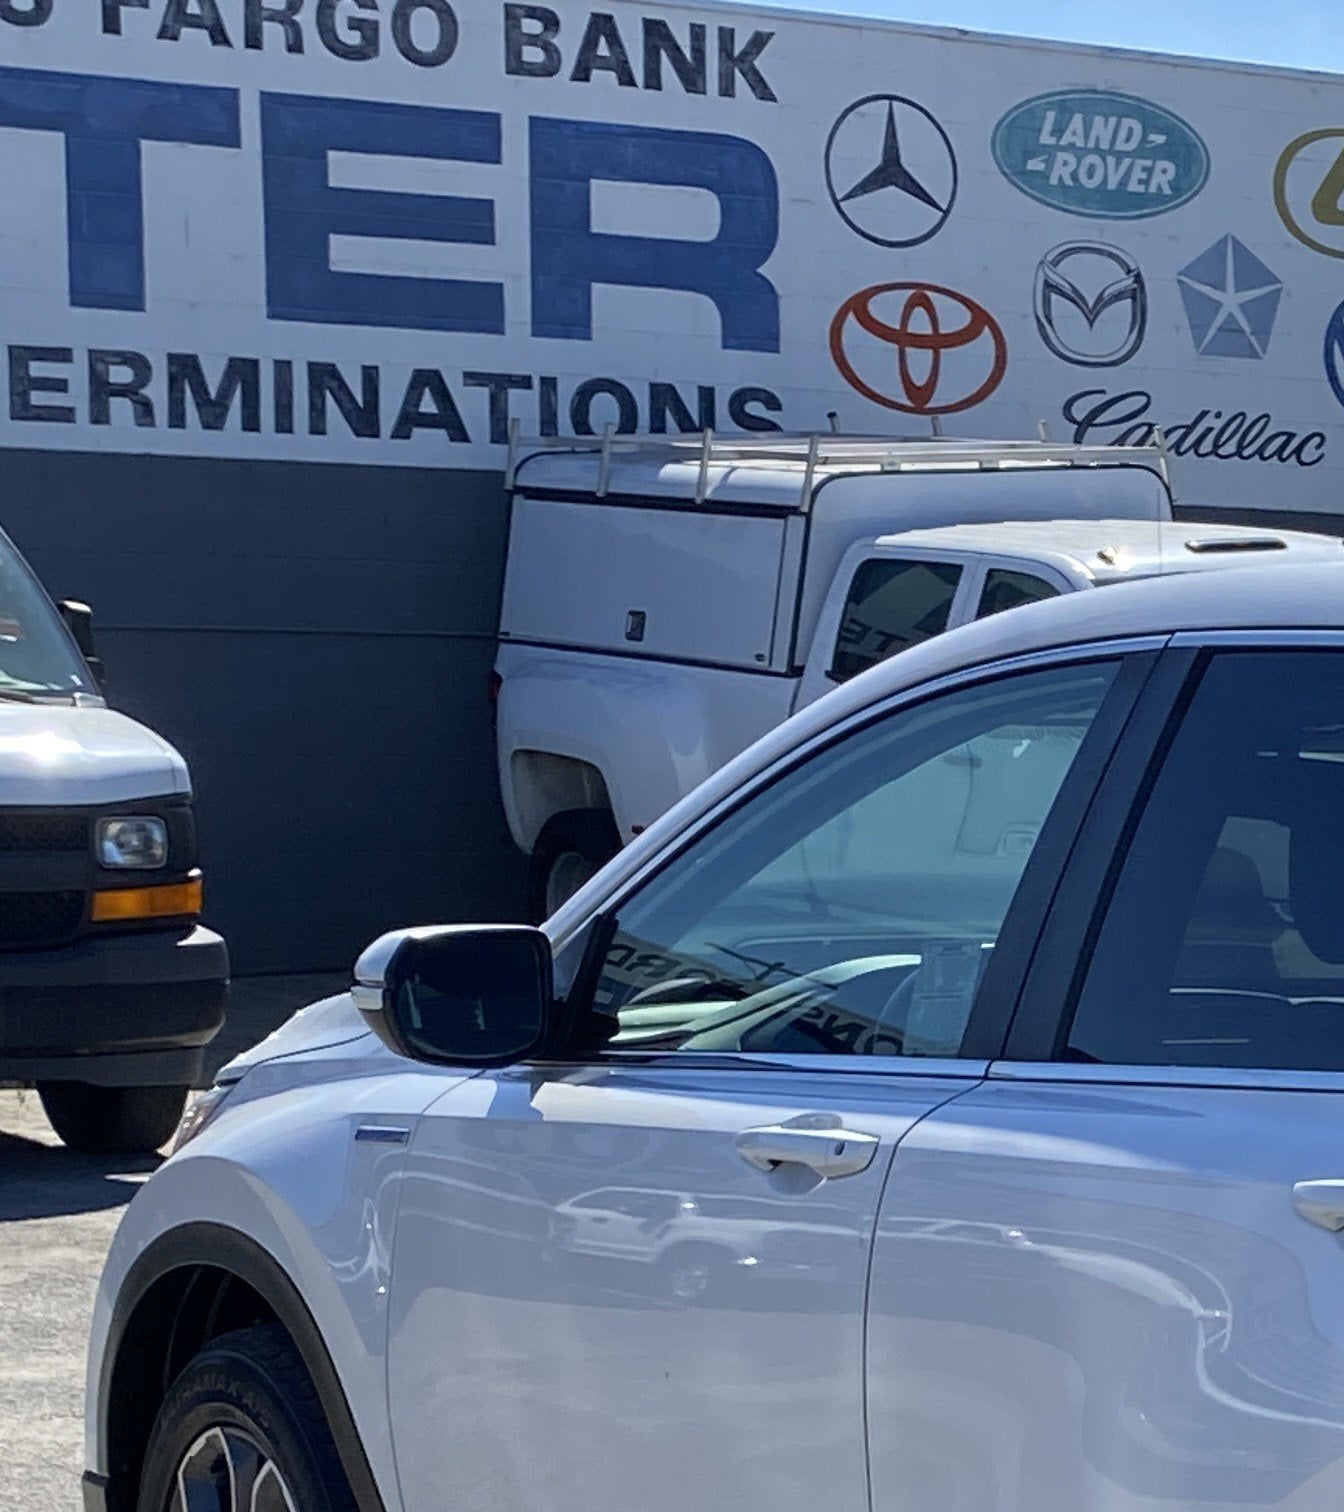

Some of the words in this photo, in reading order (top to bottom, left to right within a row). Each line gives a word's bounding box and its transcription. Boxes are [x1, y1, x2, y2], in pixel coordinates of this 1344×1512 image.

[505, 3, 779, 103] BANK
[0, 66, 781, 354] TER
[7, 344, 783, 445] ERMINATIONS
[1062, 389, 1326, 466] Cadillac
